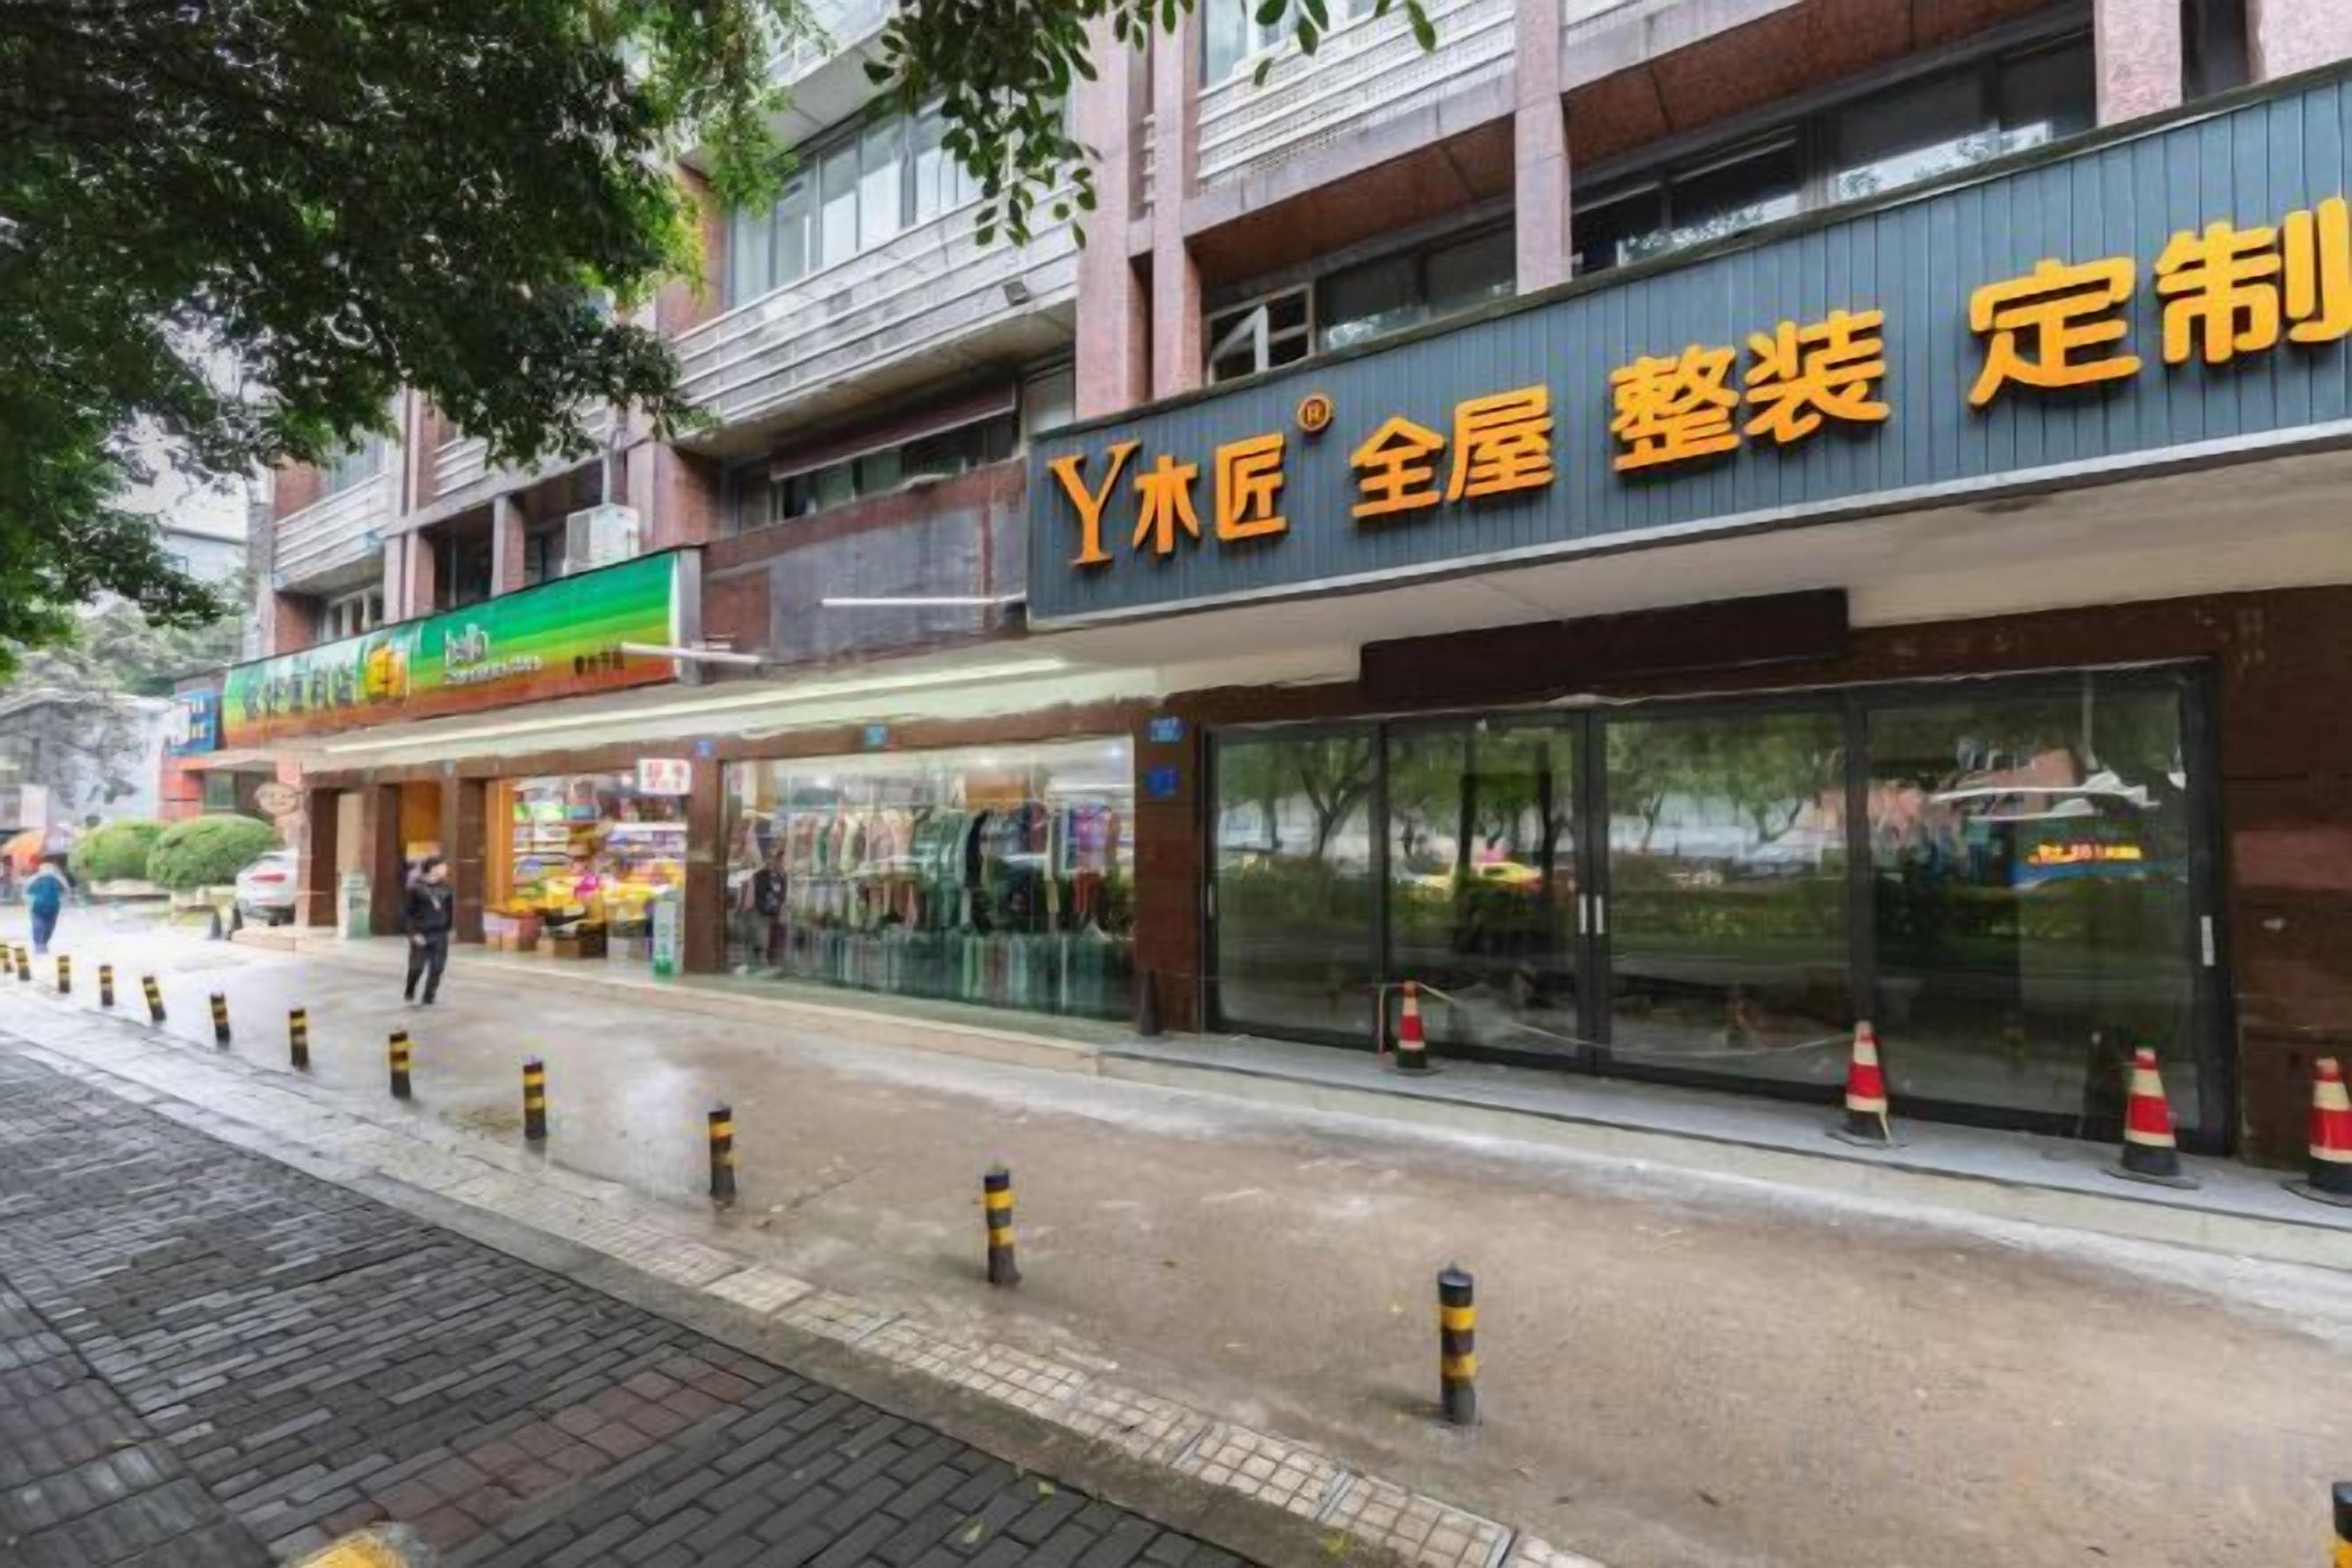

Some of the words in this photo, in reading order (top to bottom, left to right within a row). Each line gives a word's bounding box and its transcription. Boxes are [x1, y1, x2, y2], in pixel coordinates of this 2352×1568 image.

[1350, 383, 1555, 518] 全屋
[1610, 309, 1891, 471] 整装
[1968, 196, 2352, 406] 定制
